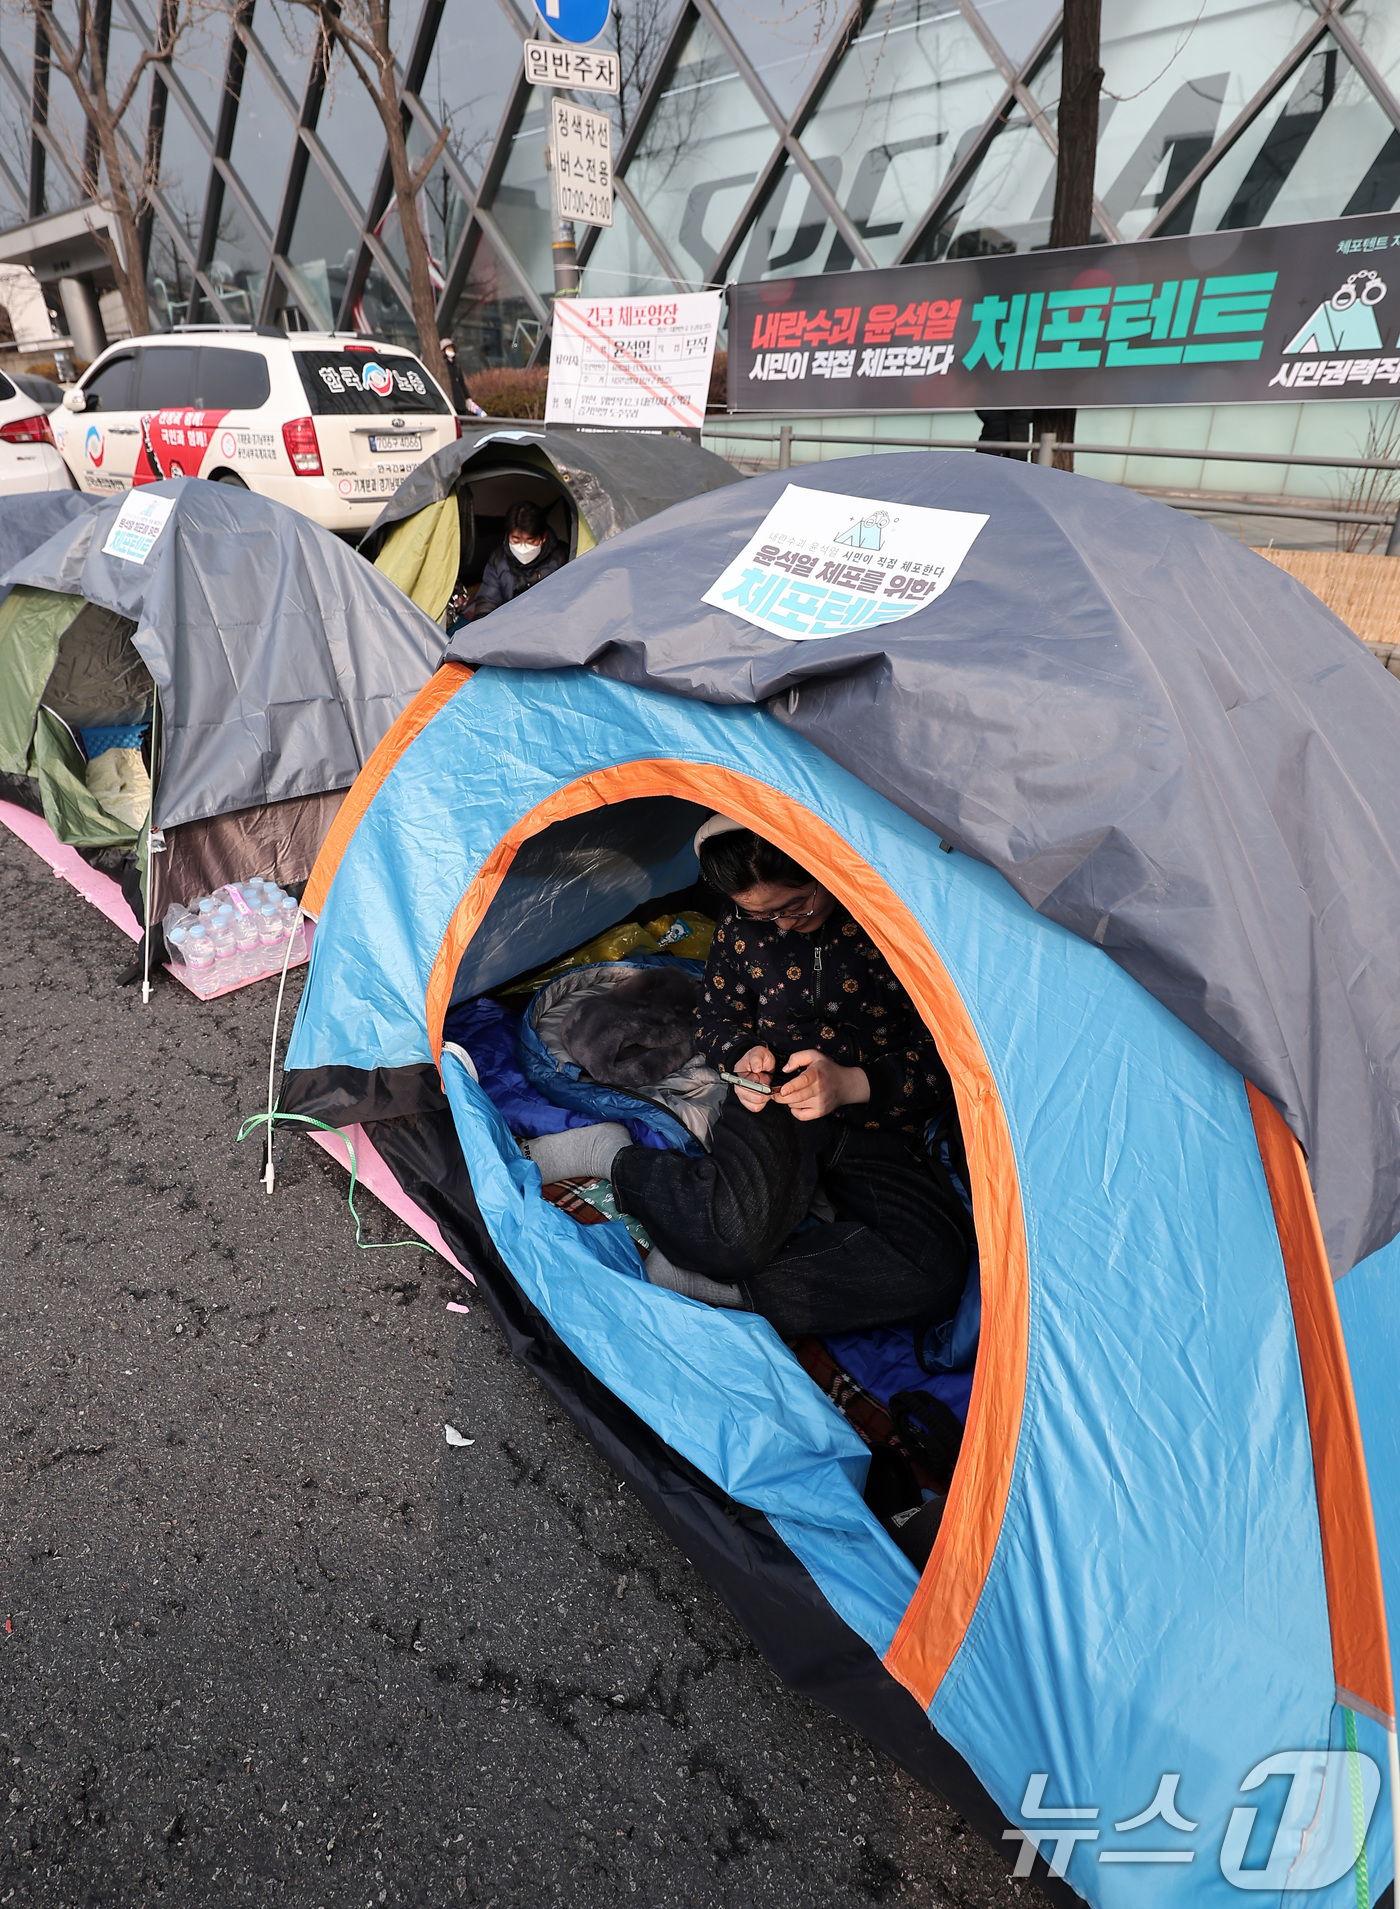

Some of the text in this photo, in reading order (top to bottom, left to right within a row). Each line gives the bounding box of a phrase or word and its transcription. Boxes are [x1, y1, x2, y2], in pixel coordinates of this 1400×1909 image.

[530, 49, 614, 86] 일반주차
[557, 108, 609, 149] 청색차선
[559, 150, 609, 187] 버스전용
[1335, 236, 1389, 255] 체포텐트
[586, 303, 678, 328] 긴급 체포영장
[750, 298, 962, 350] 내란수괴 윤석열
[961, 270, 1278, 372] 체포텐트
[613, 339, 651, 359] 윤석열
[685, 336, 708, 355] 무직
[748, 344, 954, 382] 시민이 직접 체포한다
[319, 366, 427, 395] 한국 노총
[160, 428, 208, 448] 국민과 함께!
[109, 530, 153, 559] 체포텐트
[768, 532, 945, 578] 내란수괴 윤석열 시민이 직접 체포한다
[753, 544, 936, 601] 윤석열 체포를 위한
